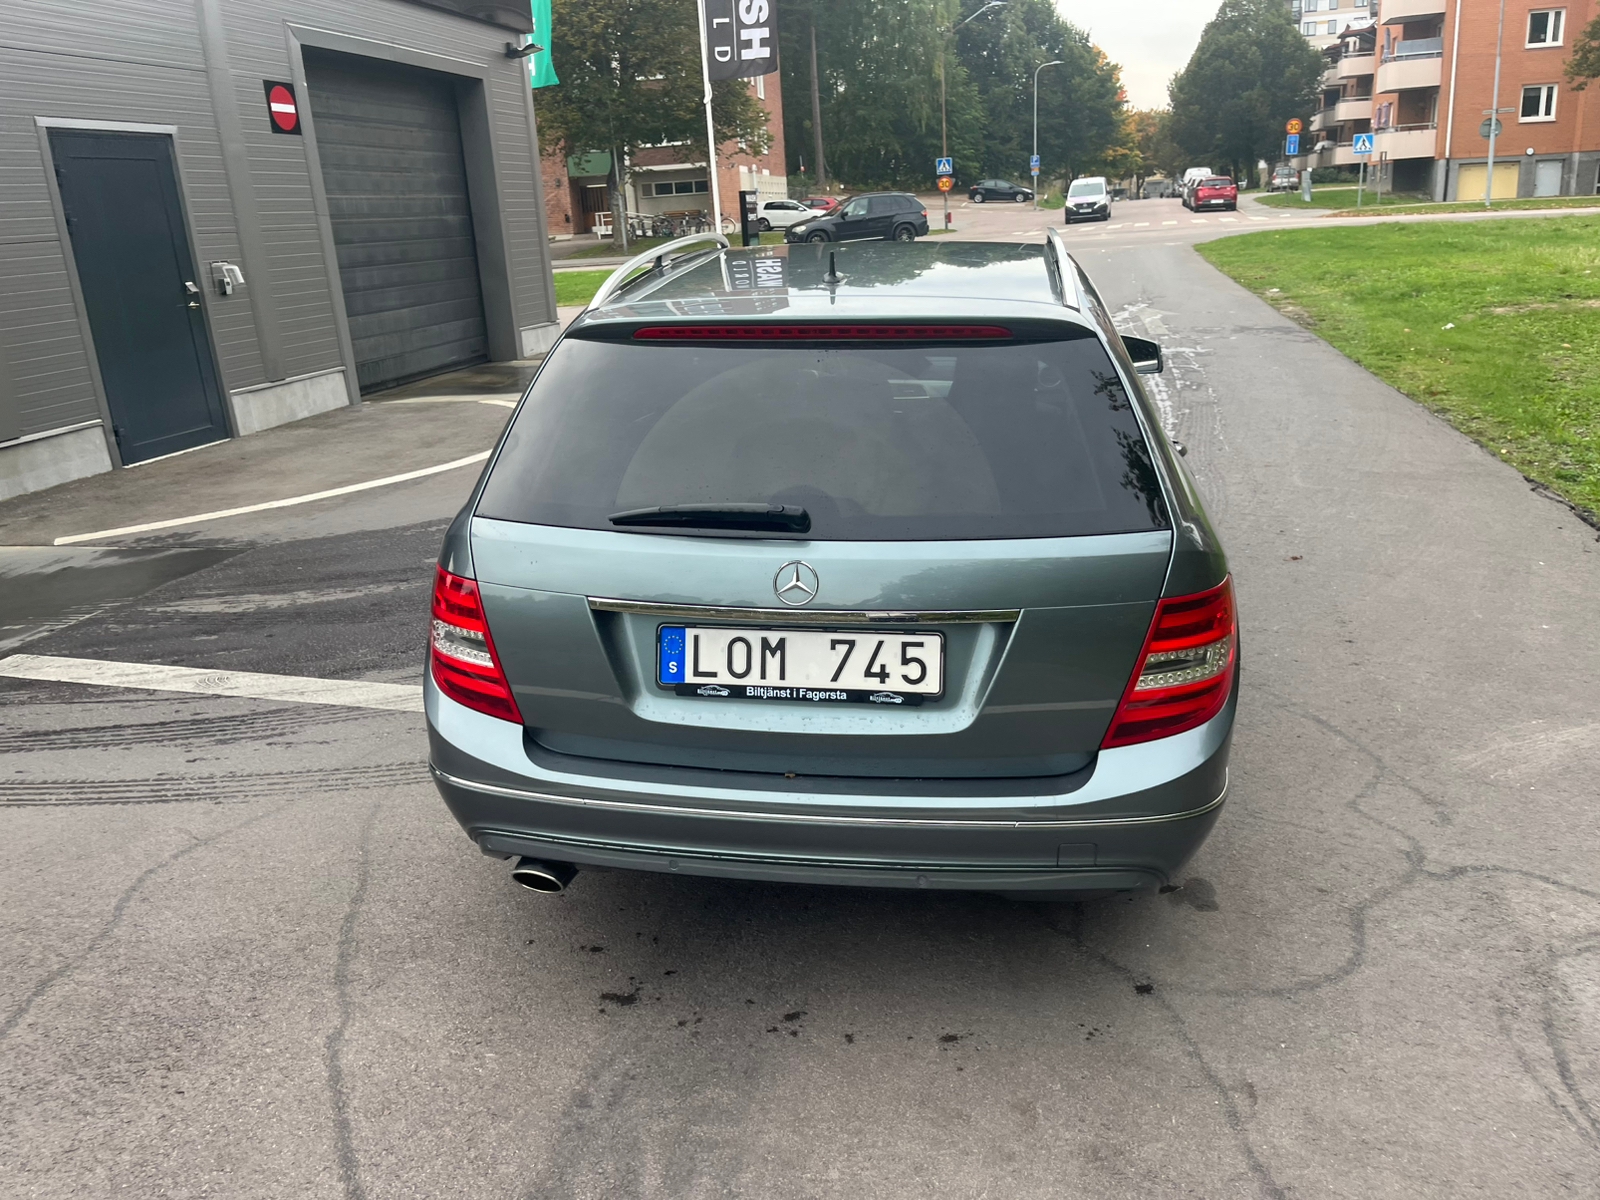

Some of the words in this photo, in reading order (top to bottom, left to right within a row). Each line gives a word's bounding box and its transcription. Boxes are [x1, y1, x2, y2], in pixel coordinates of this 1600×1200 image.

[1288, 122, 1299, 130] 30
[939, 180, 950, 188] 30
[692, 634, 786, 681] LOM
[829, 639, 927, 685] 745
[668, 661, 678, 674] S
[746, 686, 791, 699] Biltjänst
[793, 688, 797, 698] i
[799, 688, 847, 701] Fagersta
